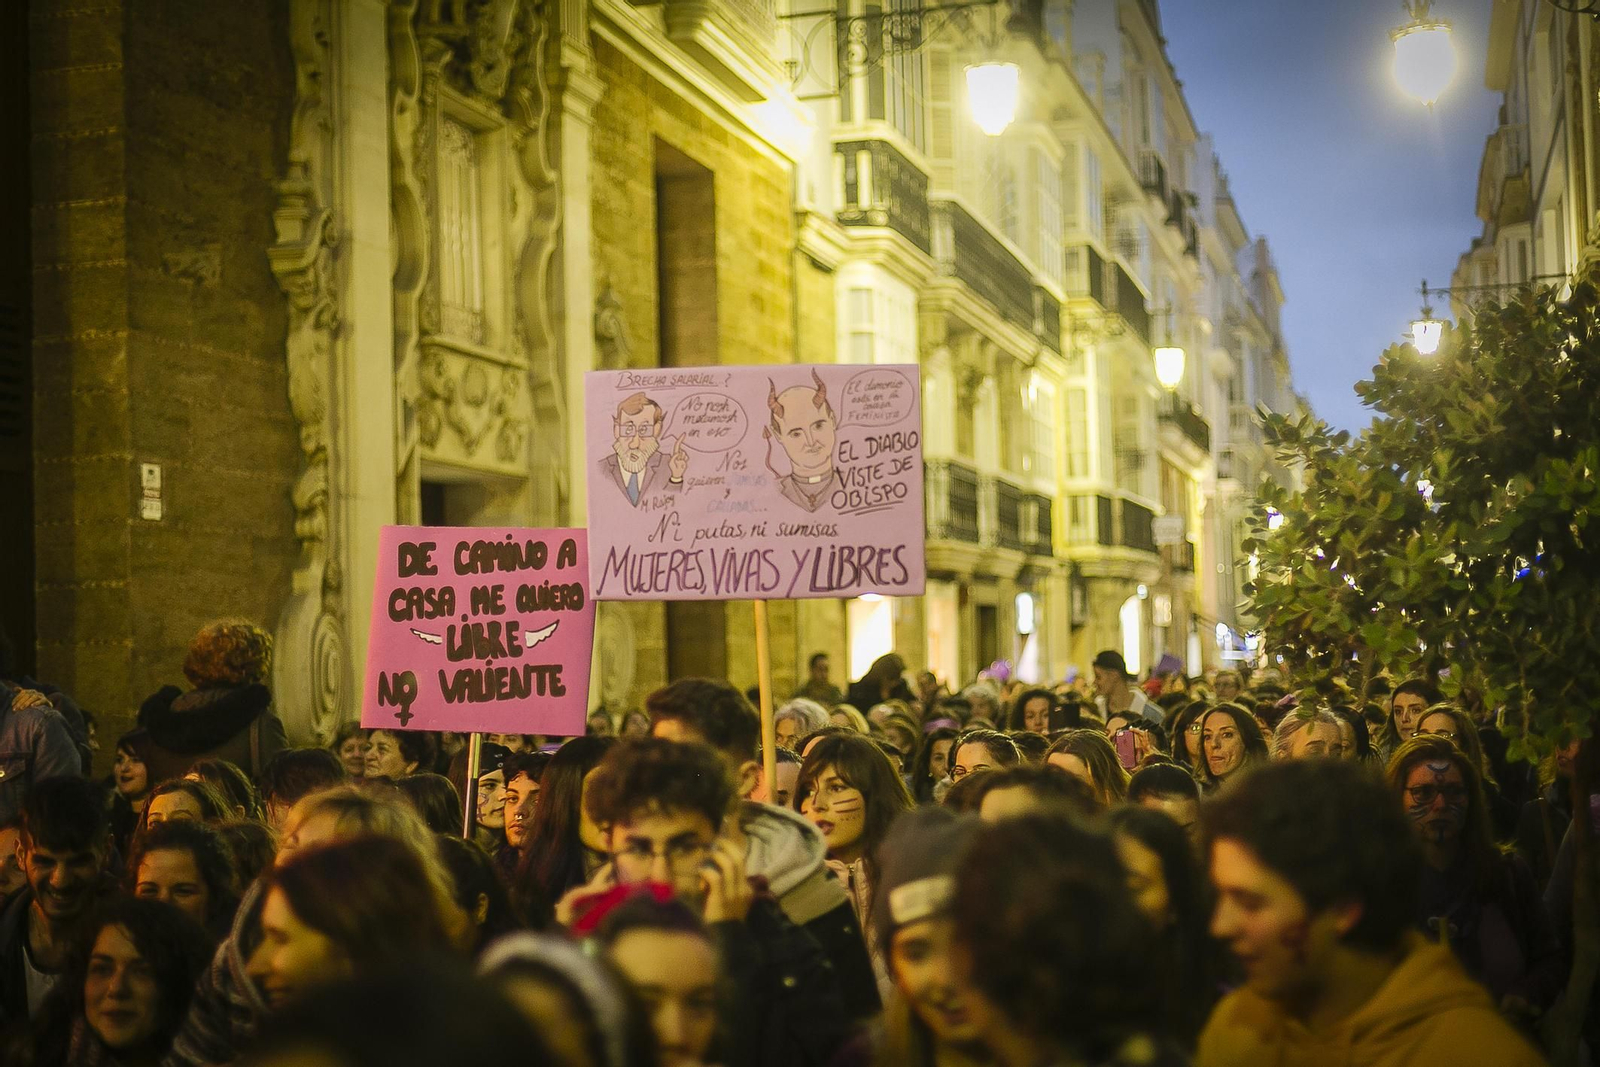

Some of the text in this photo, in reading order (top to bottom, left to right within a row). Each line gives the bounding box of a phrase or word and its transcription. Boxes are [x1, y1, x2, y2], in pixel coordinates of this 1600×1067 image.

[616, 371, 667, 388] BRECHA
[847, 380, 861, 394] El
[681, 396, 703, 411] No
[688, 427, 732, 437] en eso
[715, 449, 747, 472] Nos
[838, 440, 859, 463] EL
[888, 455, 913, 475] DE
[652, 494, 675, 511] Rajoy
[647, 511, 683, 543] Ni
[751, 521, 767, 537] ni
[398, 541, 439, 578] DE
[556, 538, 578, 570] A
[785, 549, 810, 598] Y
[388, 586, 456, 622] CASA
[470, 584, 507, 616] ME
[378, 670, 418, 727] NO
